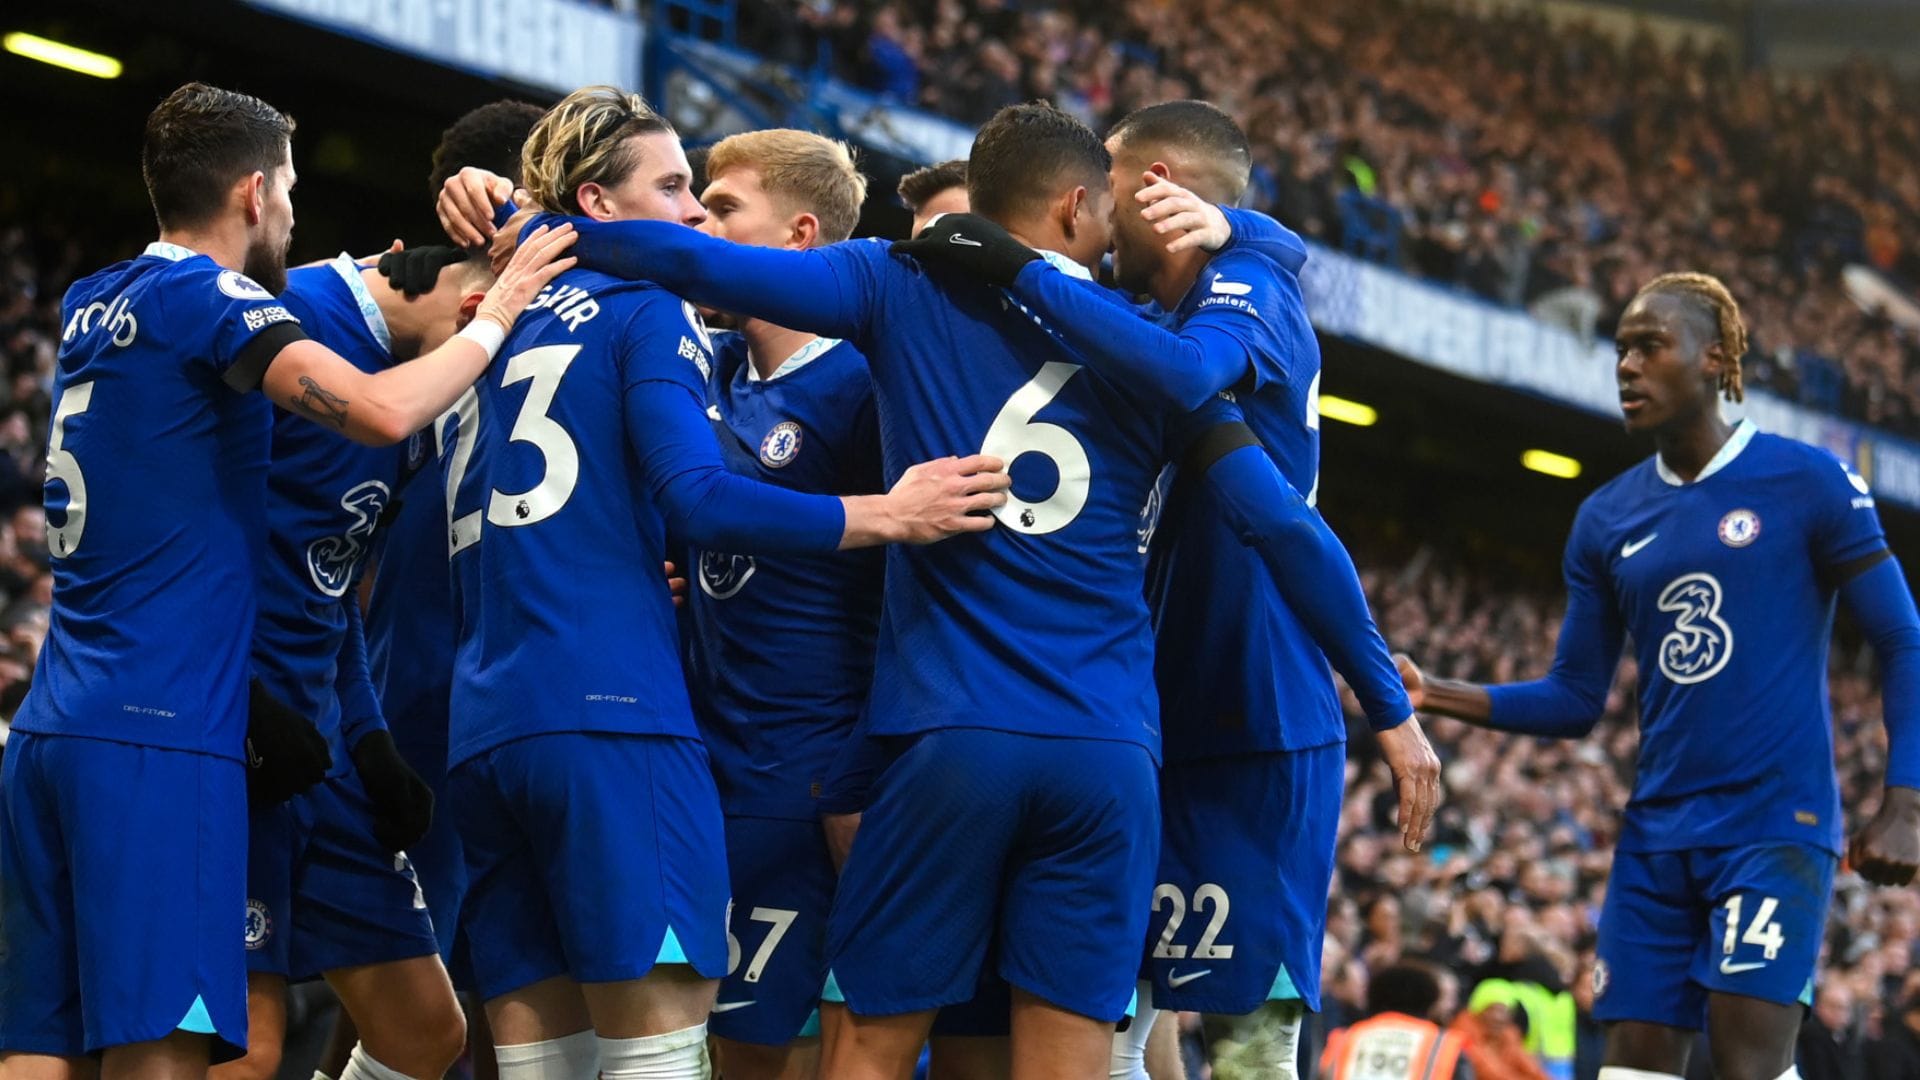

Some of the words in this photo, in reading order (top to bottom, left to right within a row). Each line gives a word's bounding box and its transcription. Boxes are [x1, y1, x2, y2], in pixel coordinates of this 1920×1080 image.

[44, 381, 95, 559] 5
[435, 344, 583, 557] 23
[980, 361, 1091, 535] 6
[1151, 882, 1234, 959] 22
[1722, 894, 1785, 960] 14
